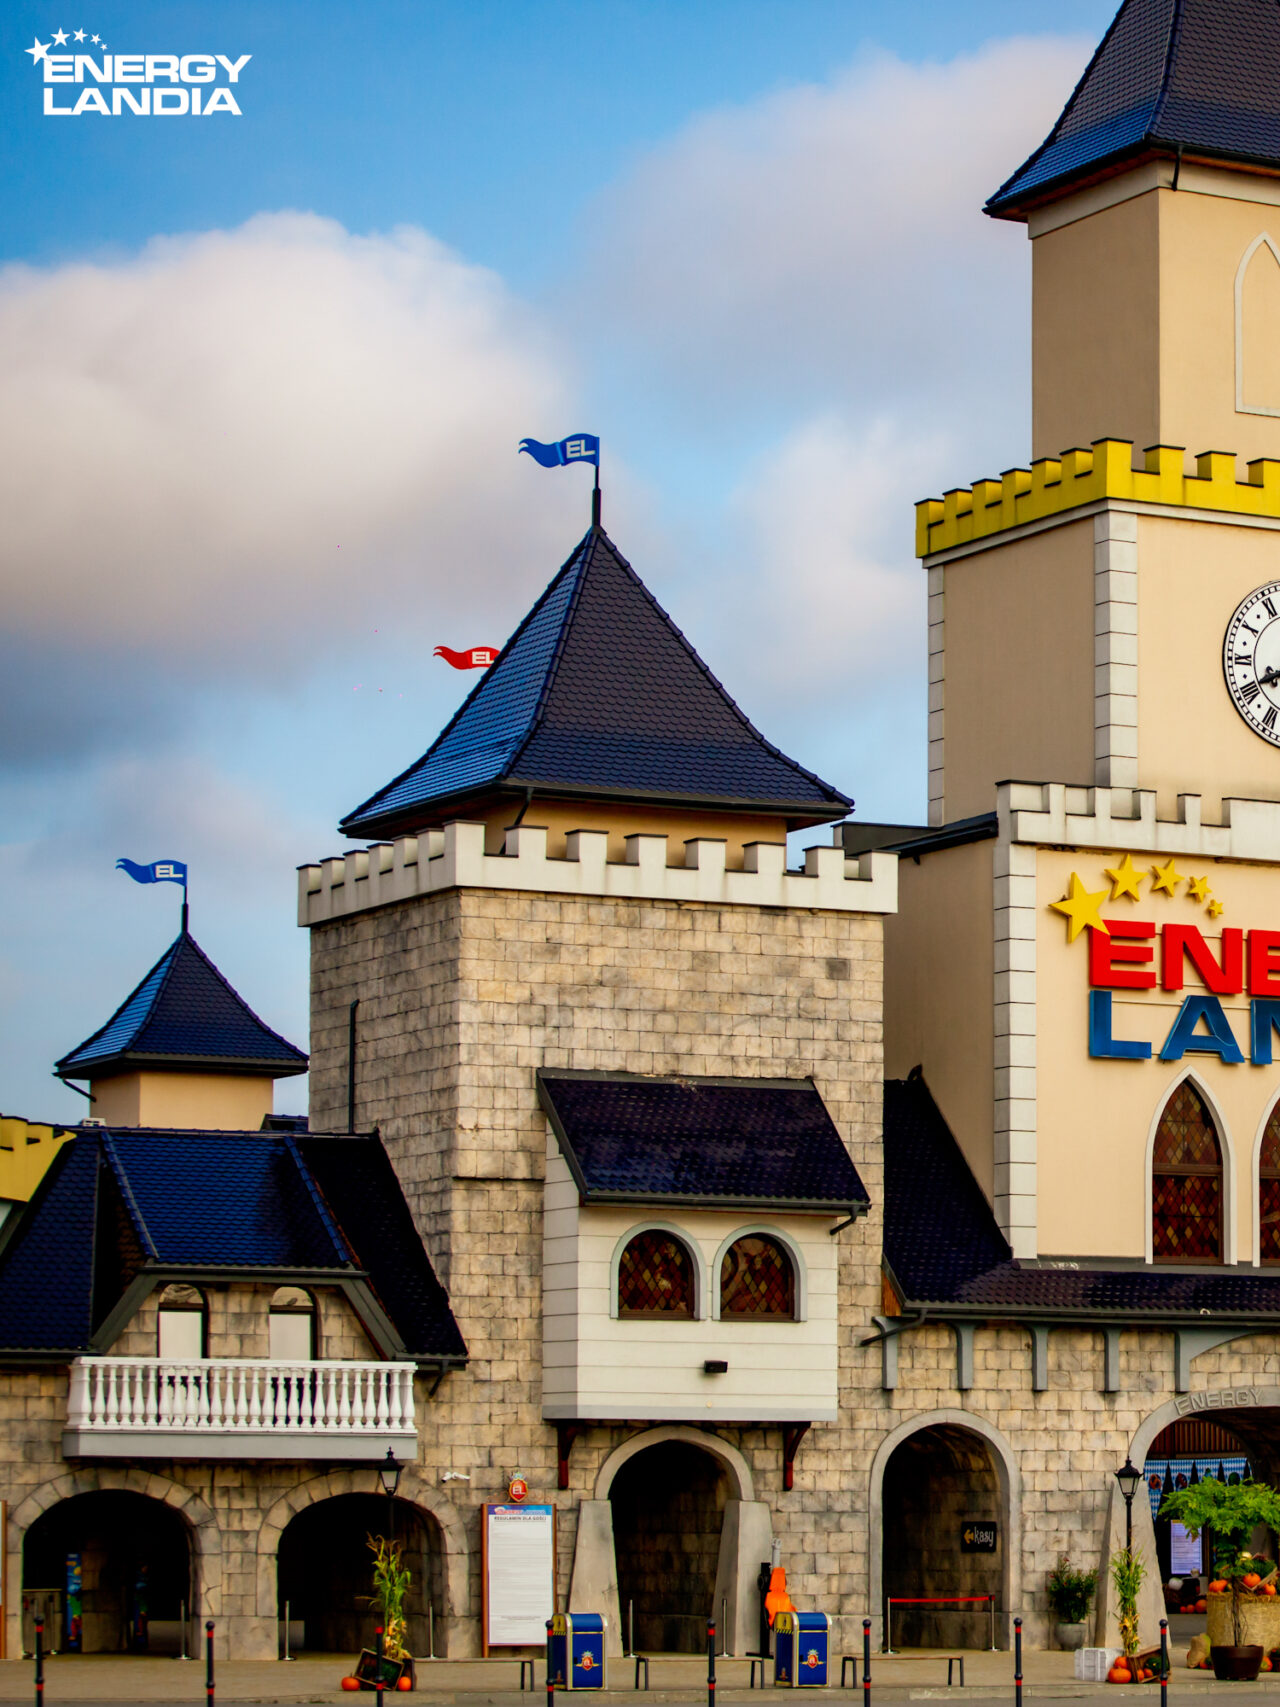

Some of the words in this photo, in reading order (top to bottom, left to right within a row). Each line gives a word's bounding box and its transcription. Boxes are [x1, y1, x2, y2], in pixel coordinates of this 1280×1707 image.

[565, 439, 595, 459] EL
[1261, 596, 1278, 620] XI
[1241, 620, 1259, 638] X
[1234, 653, 1252, 666] IX
[155, 864, 184, 878] EL
[1174, 1388, 1263, 1416] ENERGY
[974, 1525, 994, 1547] kasy
